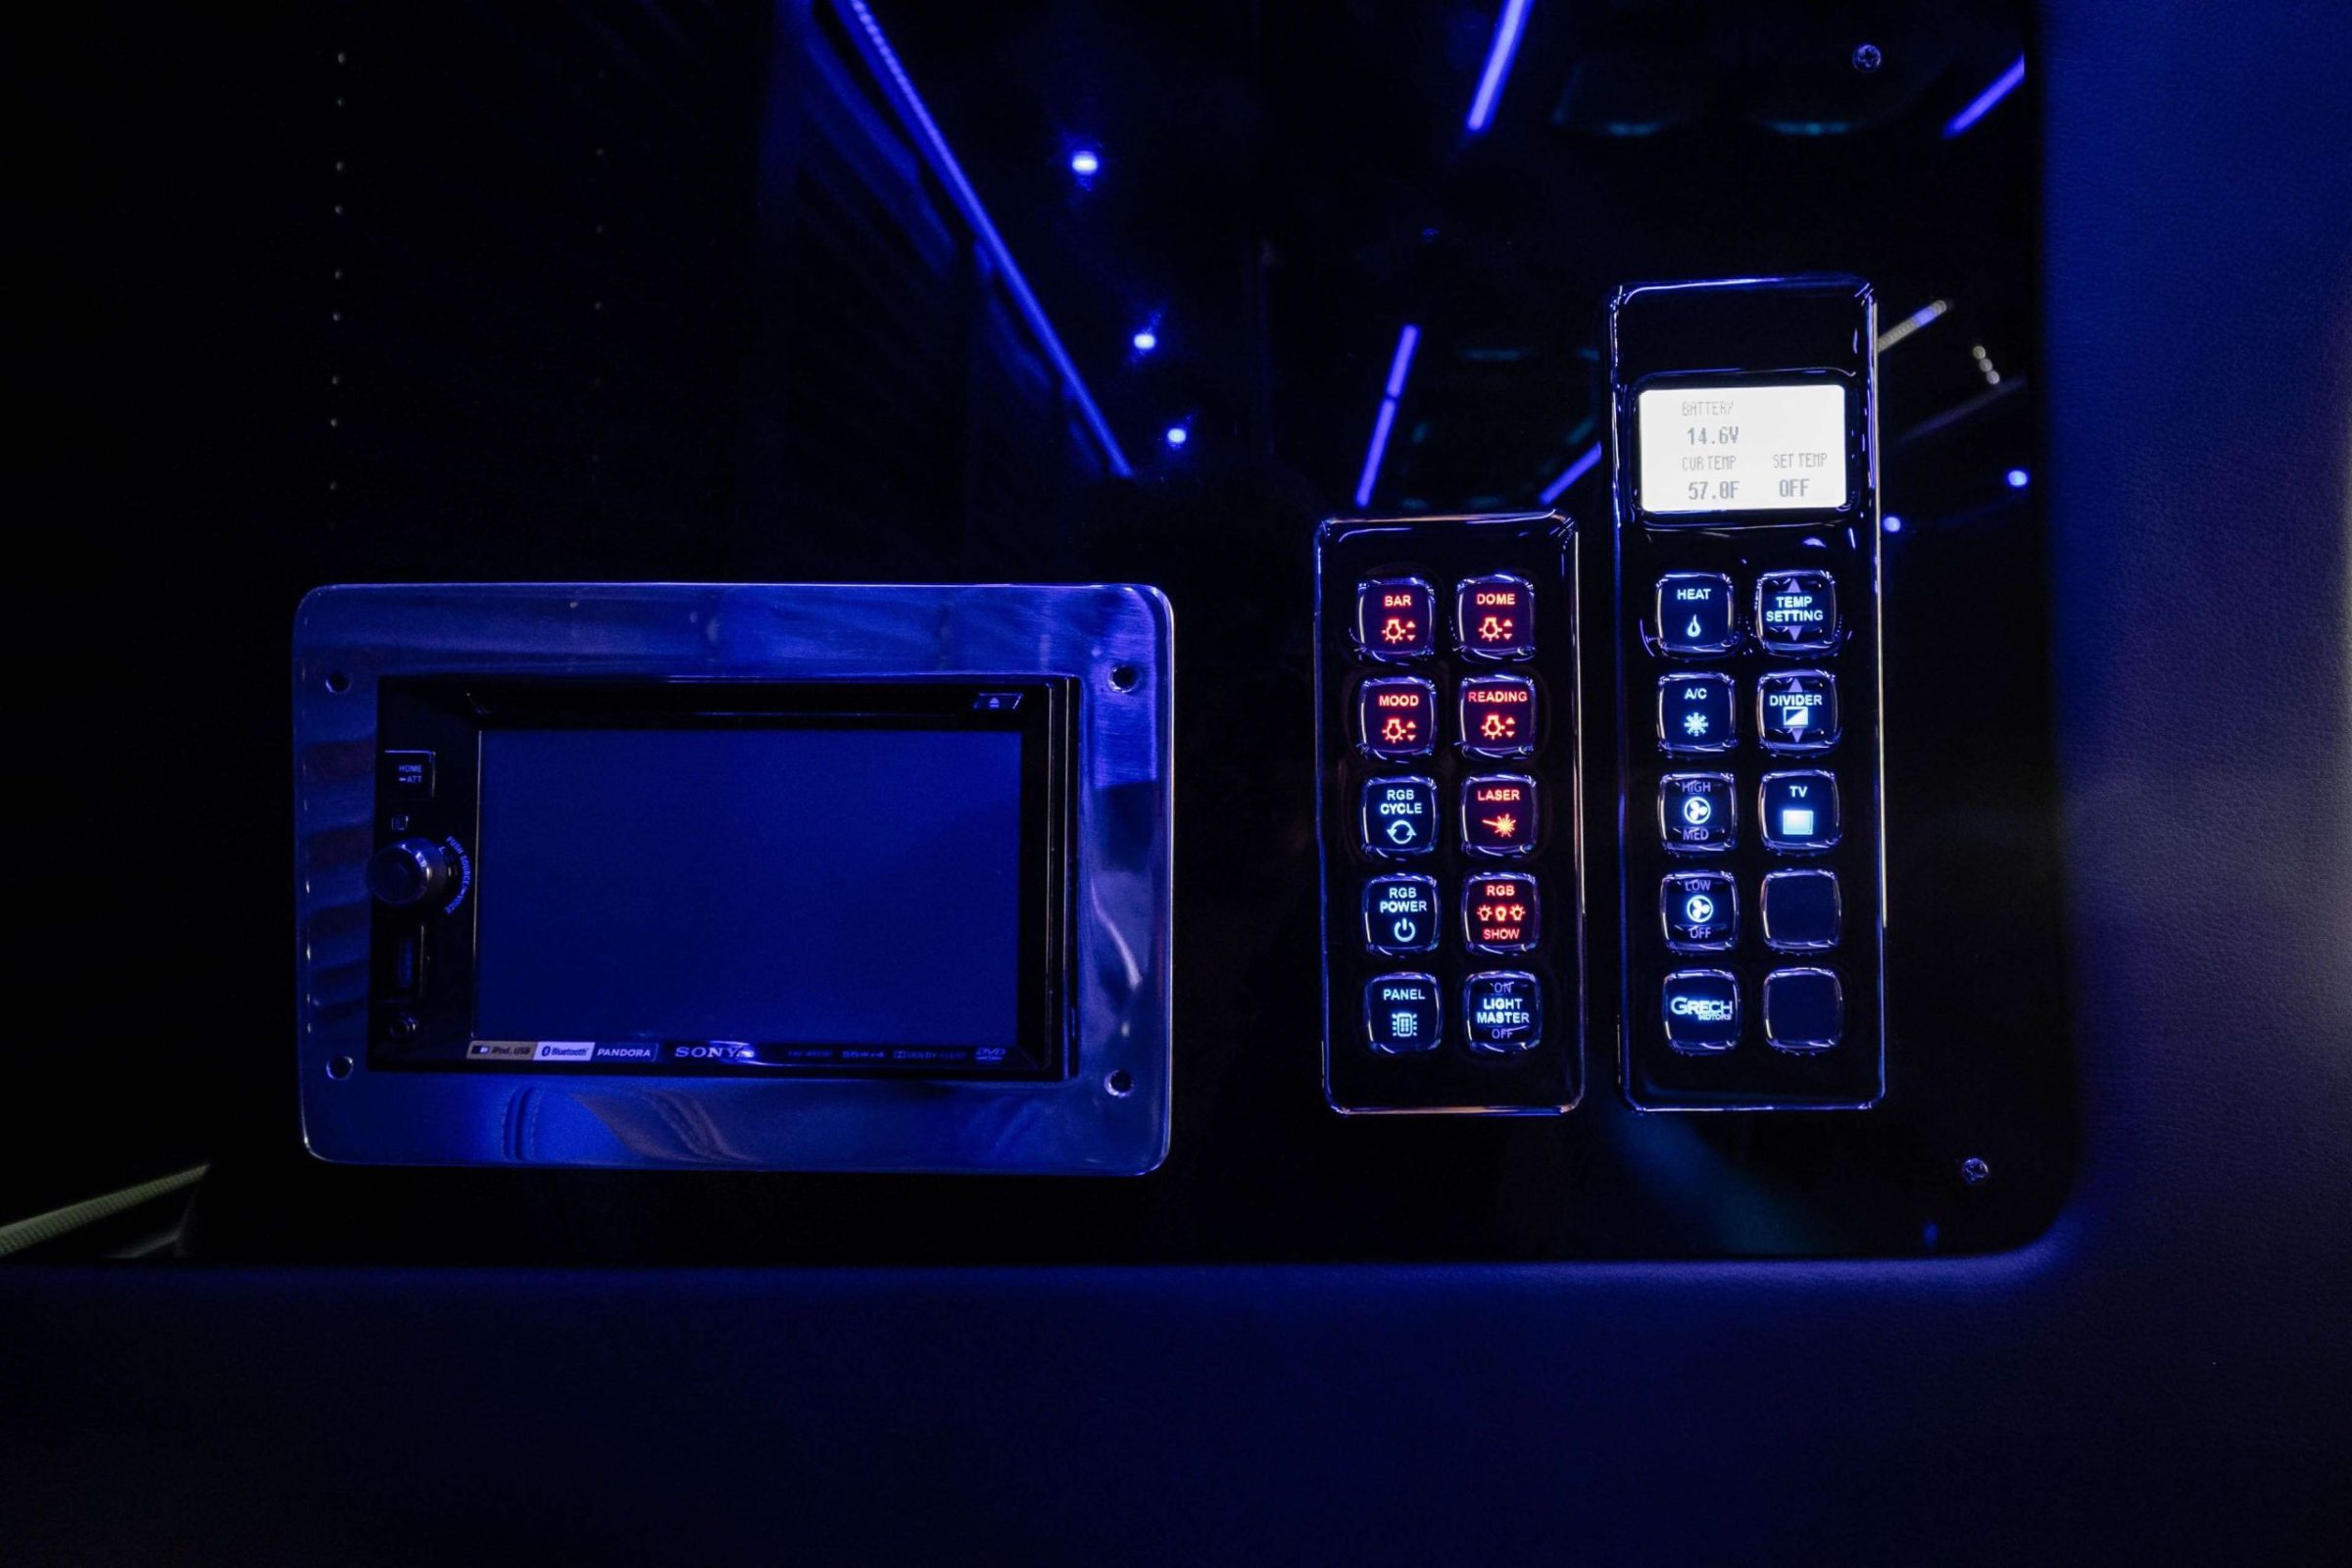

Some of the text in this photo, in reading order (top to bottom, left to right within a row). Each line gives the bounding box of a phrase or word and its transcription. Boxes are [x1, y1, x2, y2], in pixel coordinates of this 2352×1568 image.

[1682, 401, 1734, 416] BATTERY
[1687, 426, 1740, 445] 14.6V
[1682, 456, 1737, 471] CUR TEMP
[1773, 453, 1828, 469] SET TEMP
[1688, 480, 1740, 500] 57.0F
[1779, 478, 1810, 498] OFF
[1476, 593, 1516, 606] DOME
[1677, 588, 1711, 600] HEAT
[1384, 594, 1412, 608] BAR
[1776, 596, 1812, 608] TEMP
[1766, 611, 1823, 621] SETTING
[1468, 691, 1528, 703] READING
[1684, 688, 1707, 700] A/C
[1379, 695, 1419, 707] MOOD
[1769, 695, 1823, 706] DIVIDER
[398, 763, 423, 773] HOME
[1682, 781, 1711, 793] HIGH
[1789, 786, 1808, 798] TV
[1387, 789, 1414, 801] RGB
[1477, 790, 1520, 802] LASER
[1380, 803, 1422, 814] CYCLE
[1683, 829, 1709, 841] MED
[1486, 885, 1515, 897] RGB
[1685, 880, 1711, 892] LOW
[1389, 887, 1417, 899] RGB
[1380, 901, 1427, 912] POWER
[1483, 928, 1520, 940] SHOW
[1690, 927, 1711, 939] OFF
[1494, 982, 1512, 994] ON
[1383, 989, 1426, 1001] PANEL
[1483, 998, 1522, 1010] LIGHT
[1477, 1011, 1530, 1024] MASTER
[1492, 1029, 1512, 1040] OFF
[597, 1048, 652, 1057] PANDORA
[674, 1046, 742, 1058] SONY
